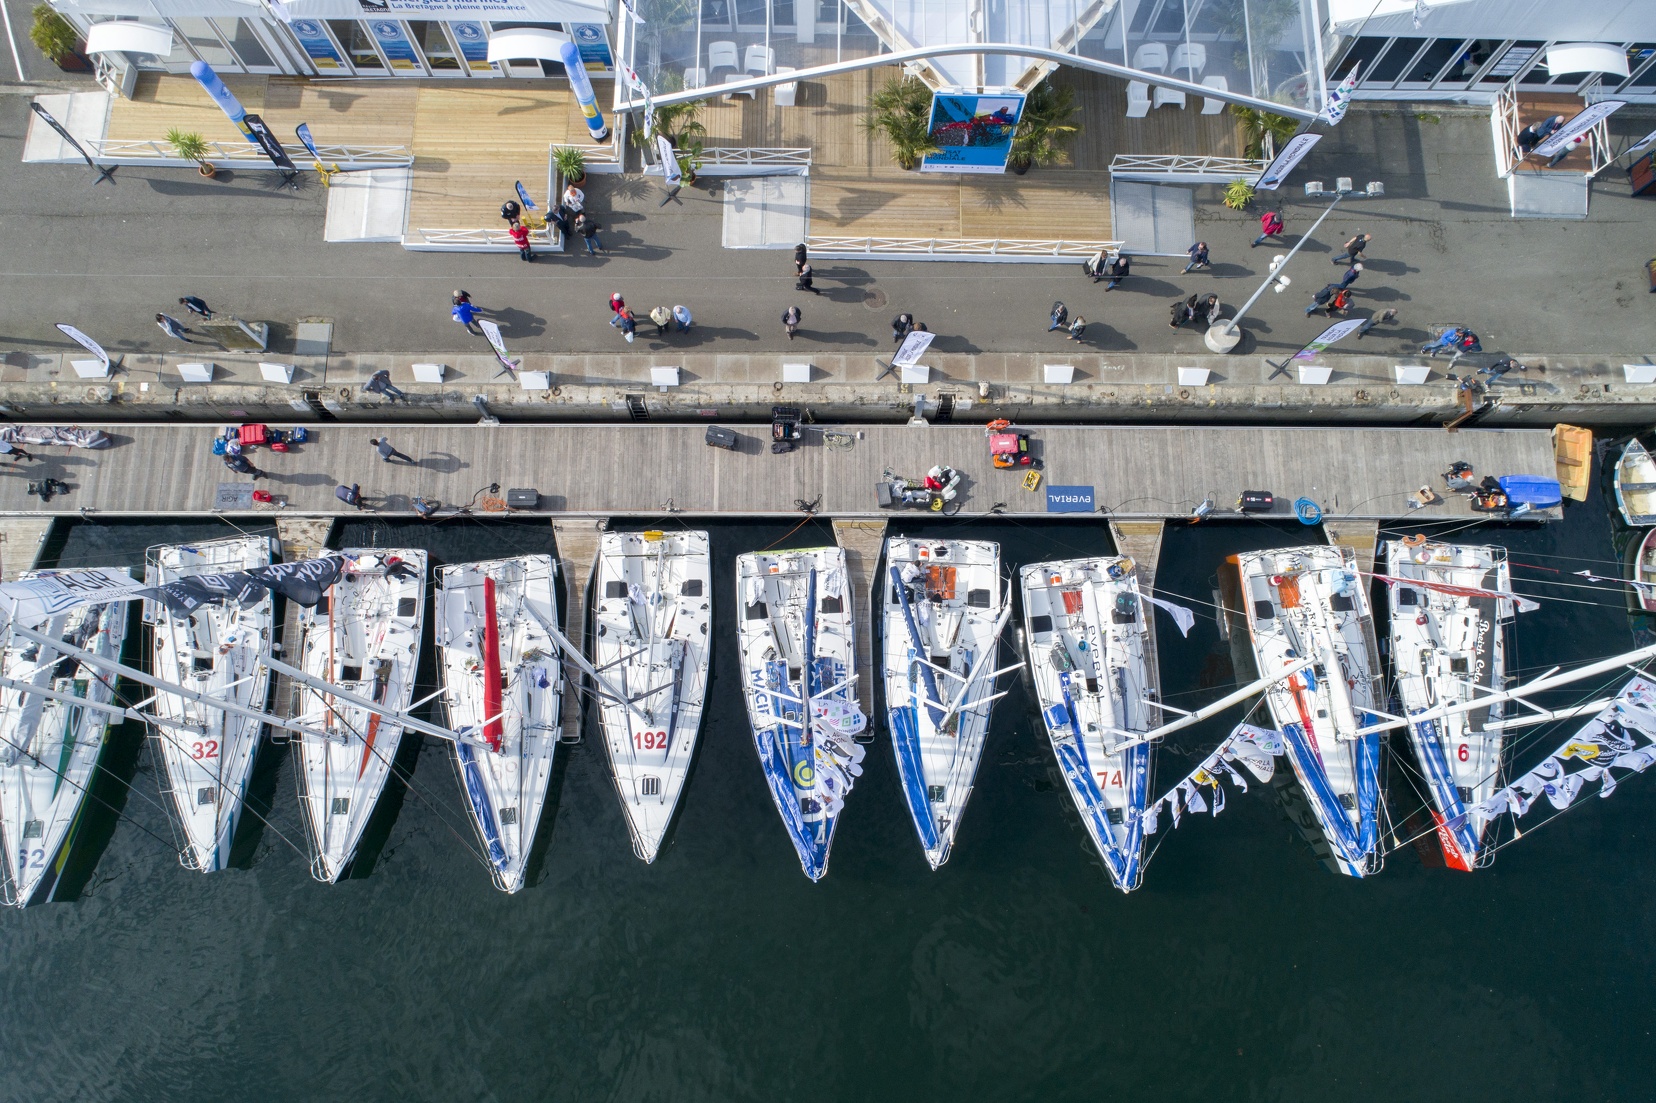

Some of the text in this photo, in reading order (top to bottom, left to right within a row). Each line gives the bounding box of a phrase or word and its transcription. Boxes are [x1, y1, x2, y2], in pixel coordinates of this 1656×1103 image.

[405, 3, 445, 11] Bretagne
[54, 570, 126, 591] AGIR
[1477, 619, 1490, 655] Breizh
[1474, 659, 1485, 684] Cola
[192, 740, 219, 760] 32
[634, 731, 667, 750] 192
[1458, 743, 1469, 762] 6
[1097, 770, 1123, 790] 74
